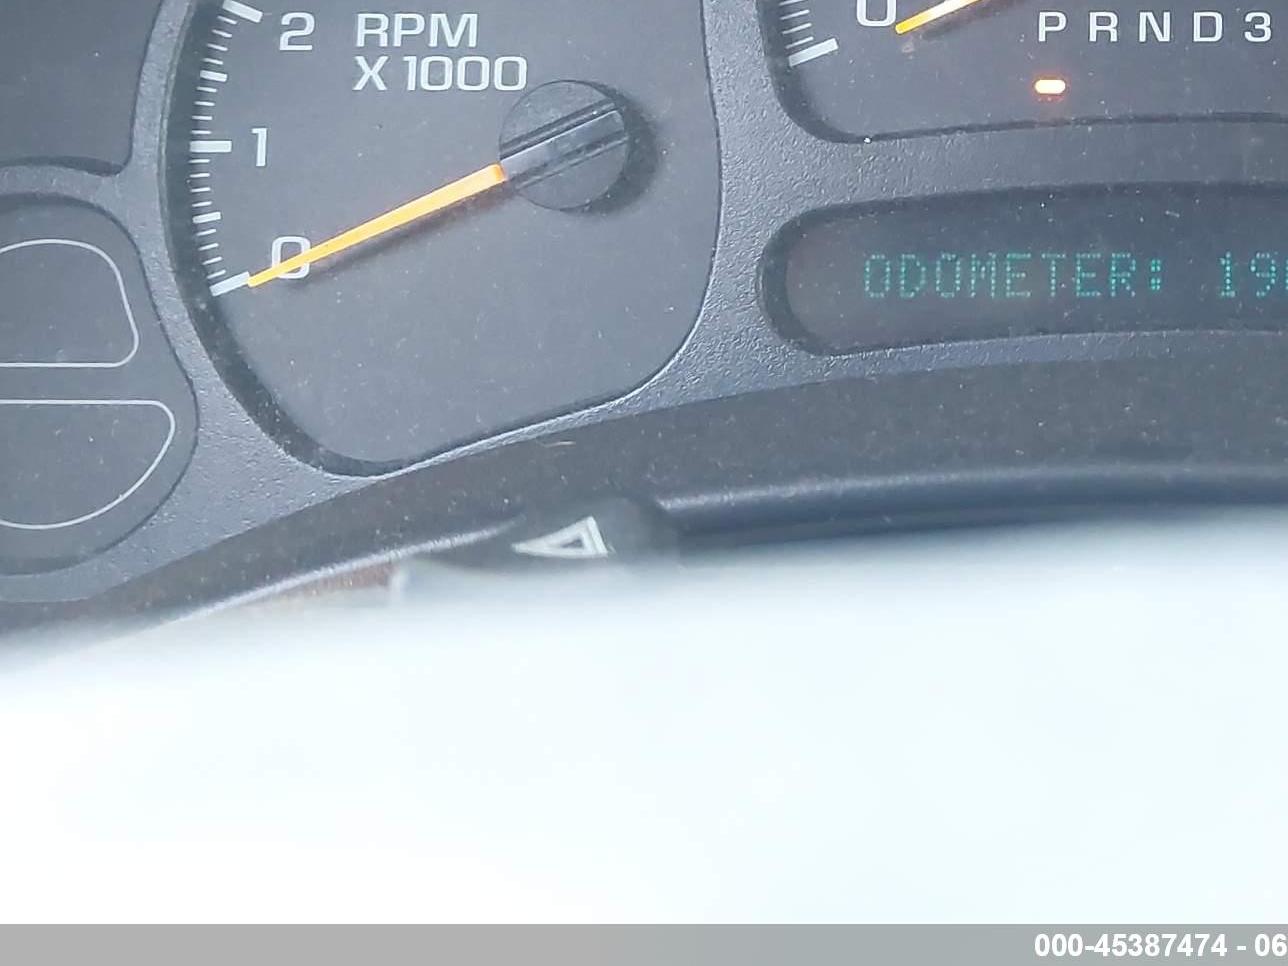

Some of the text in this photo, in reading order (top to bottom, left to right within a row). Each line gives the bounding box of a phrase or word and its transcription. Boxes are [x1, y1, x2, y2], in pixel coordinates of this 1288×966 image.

[279, 12, 315, 51] 2
[356, 13, 478, 48] RPM
[1038, 11, 1067, 42] P
[1089, 11, 1118, 42] R
[1139, 11, 1171, 43] N
[1193, 11, 1223, 42] D
[1244, 11, 1272, 42] 3
[352, 55, 528, 91] X 1000
[251, 127, 268, 167] 1
[271, 235, 311, 279] 0
[863, 252, 1162, 298] ODOMETER:
